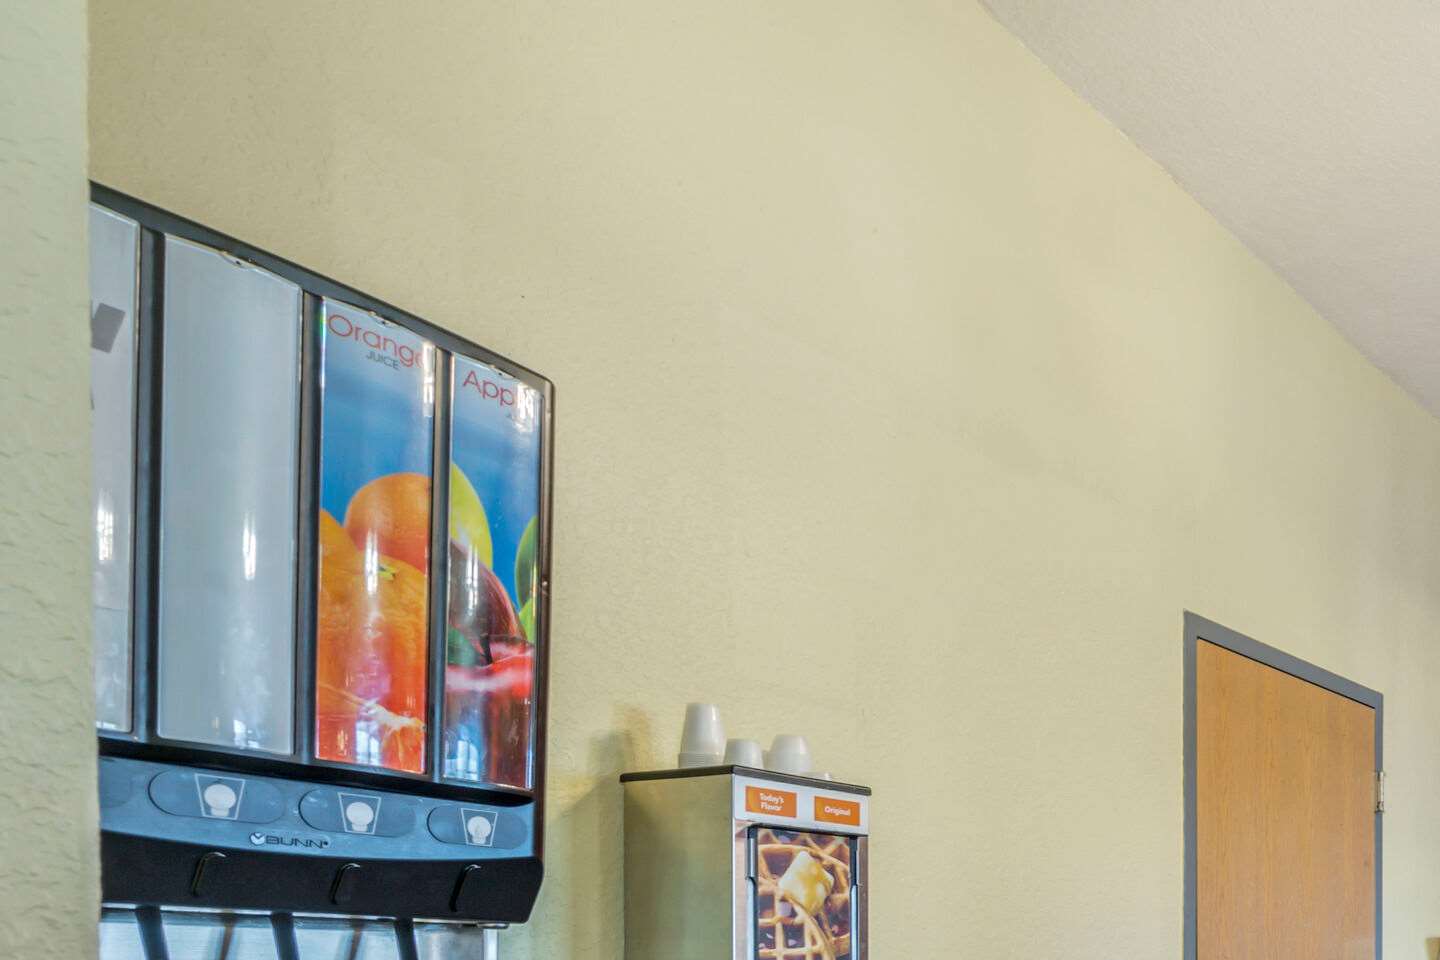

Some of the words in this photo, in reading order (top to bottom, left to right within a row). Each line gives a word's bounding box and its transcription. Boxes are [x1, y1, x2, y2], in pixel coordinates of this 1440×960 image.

[366, 351, 400, 371] JUICE
[760, 793, 785, 804] Today's
[760, 801, 783, 811] Flavor
[824, 805, 851, 816] Original
[265, 835, 324, 848] BUNN
